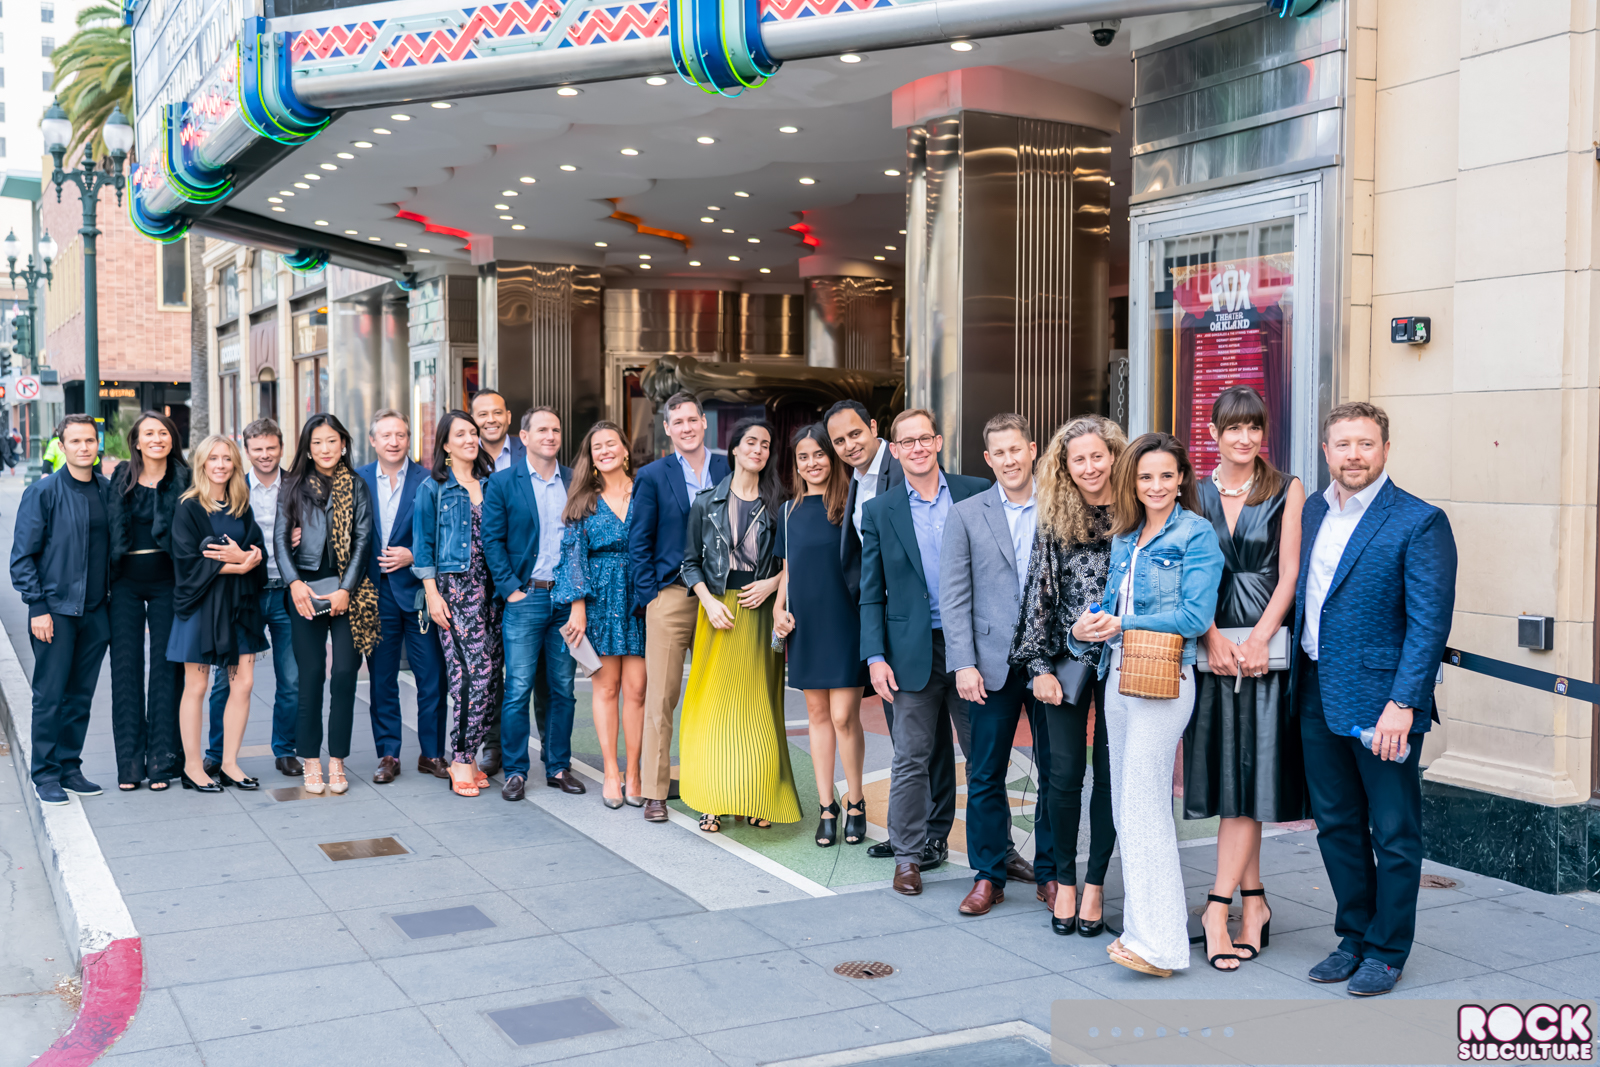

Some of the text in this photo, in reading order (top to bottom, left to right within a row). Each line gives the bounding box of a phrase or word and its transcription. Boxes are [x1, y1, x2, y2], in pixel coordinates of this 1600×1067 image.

[1210, 269, 1251, 312] FOX
[1215, 311, 1244, 322] THEATER
[1209, 318, 1250, 332] OAKLAND
